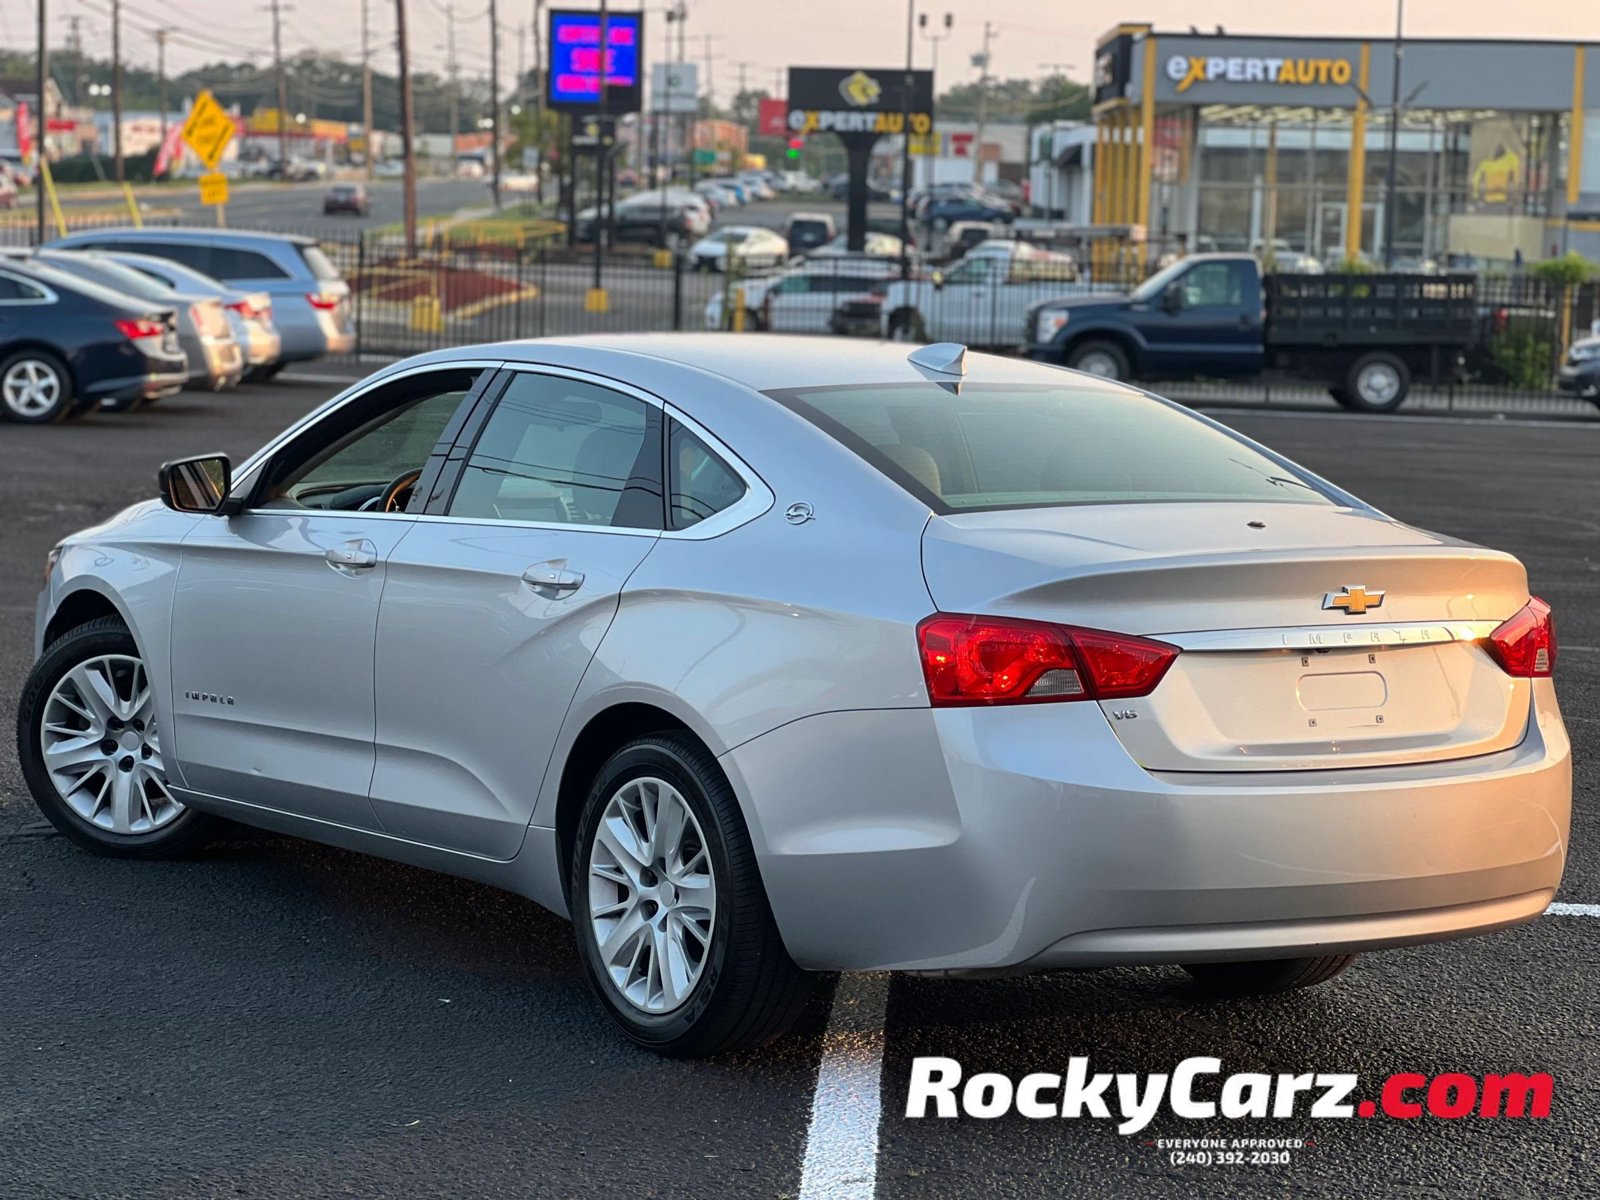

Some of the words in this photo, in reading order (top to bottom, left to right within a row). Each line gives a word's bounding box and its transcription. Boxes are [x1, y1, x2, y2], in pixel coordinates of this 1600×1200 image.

[1281, 628, 1431, 646] IMPALA
[185, 690, 235, 706] IMPALA
[1112, 709, 1138, 720] V6
